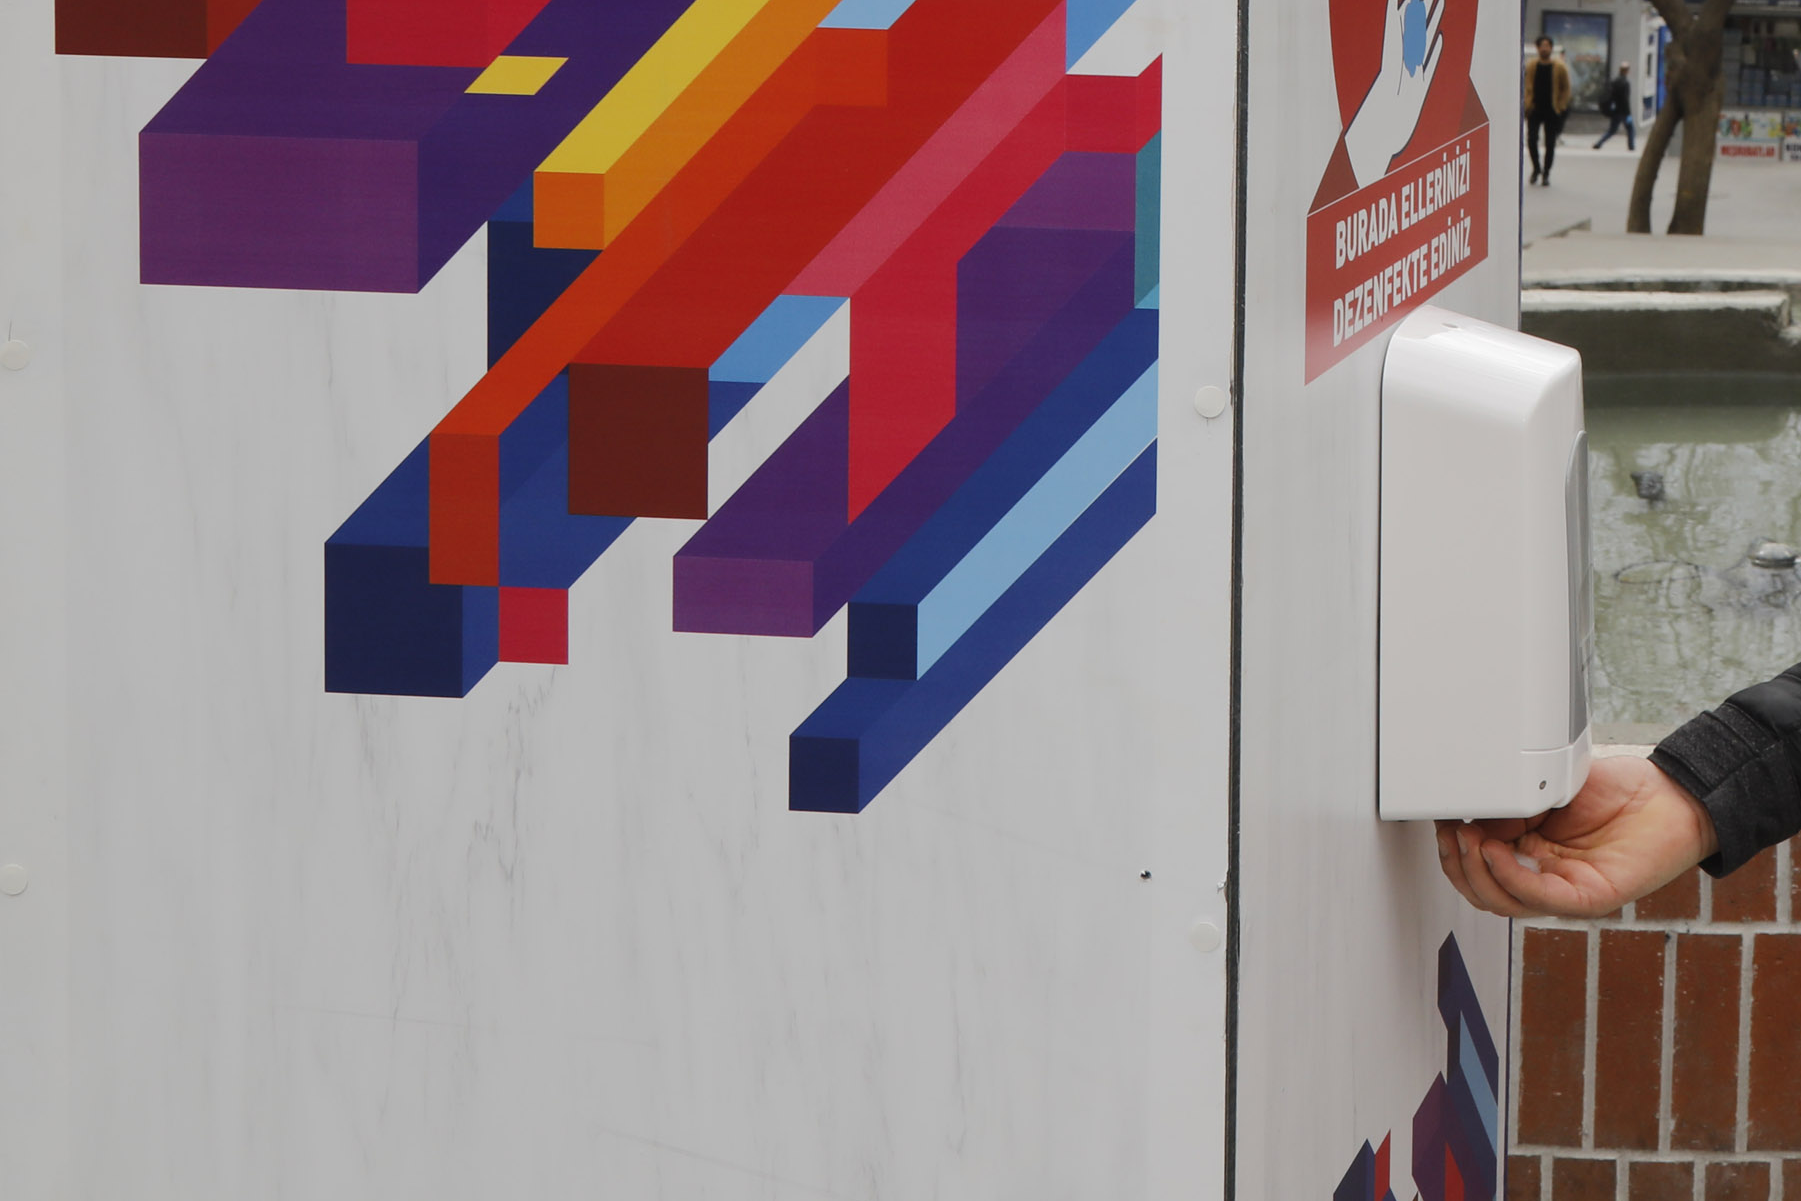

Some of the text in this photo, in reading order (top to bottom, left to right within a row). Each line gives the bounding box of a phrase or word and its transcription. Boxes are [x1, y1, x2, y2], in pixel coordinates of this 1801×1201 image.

[1336, 139, 1470, 270] BURADA ELLERİNİZİ
[1333, 208, 1471, 348] DEZENFEKTE EDİNİZ
